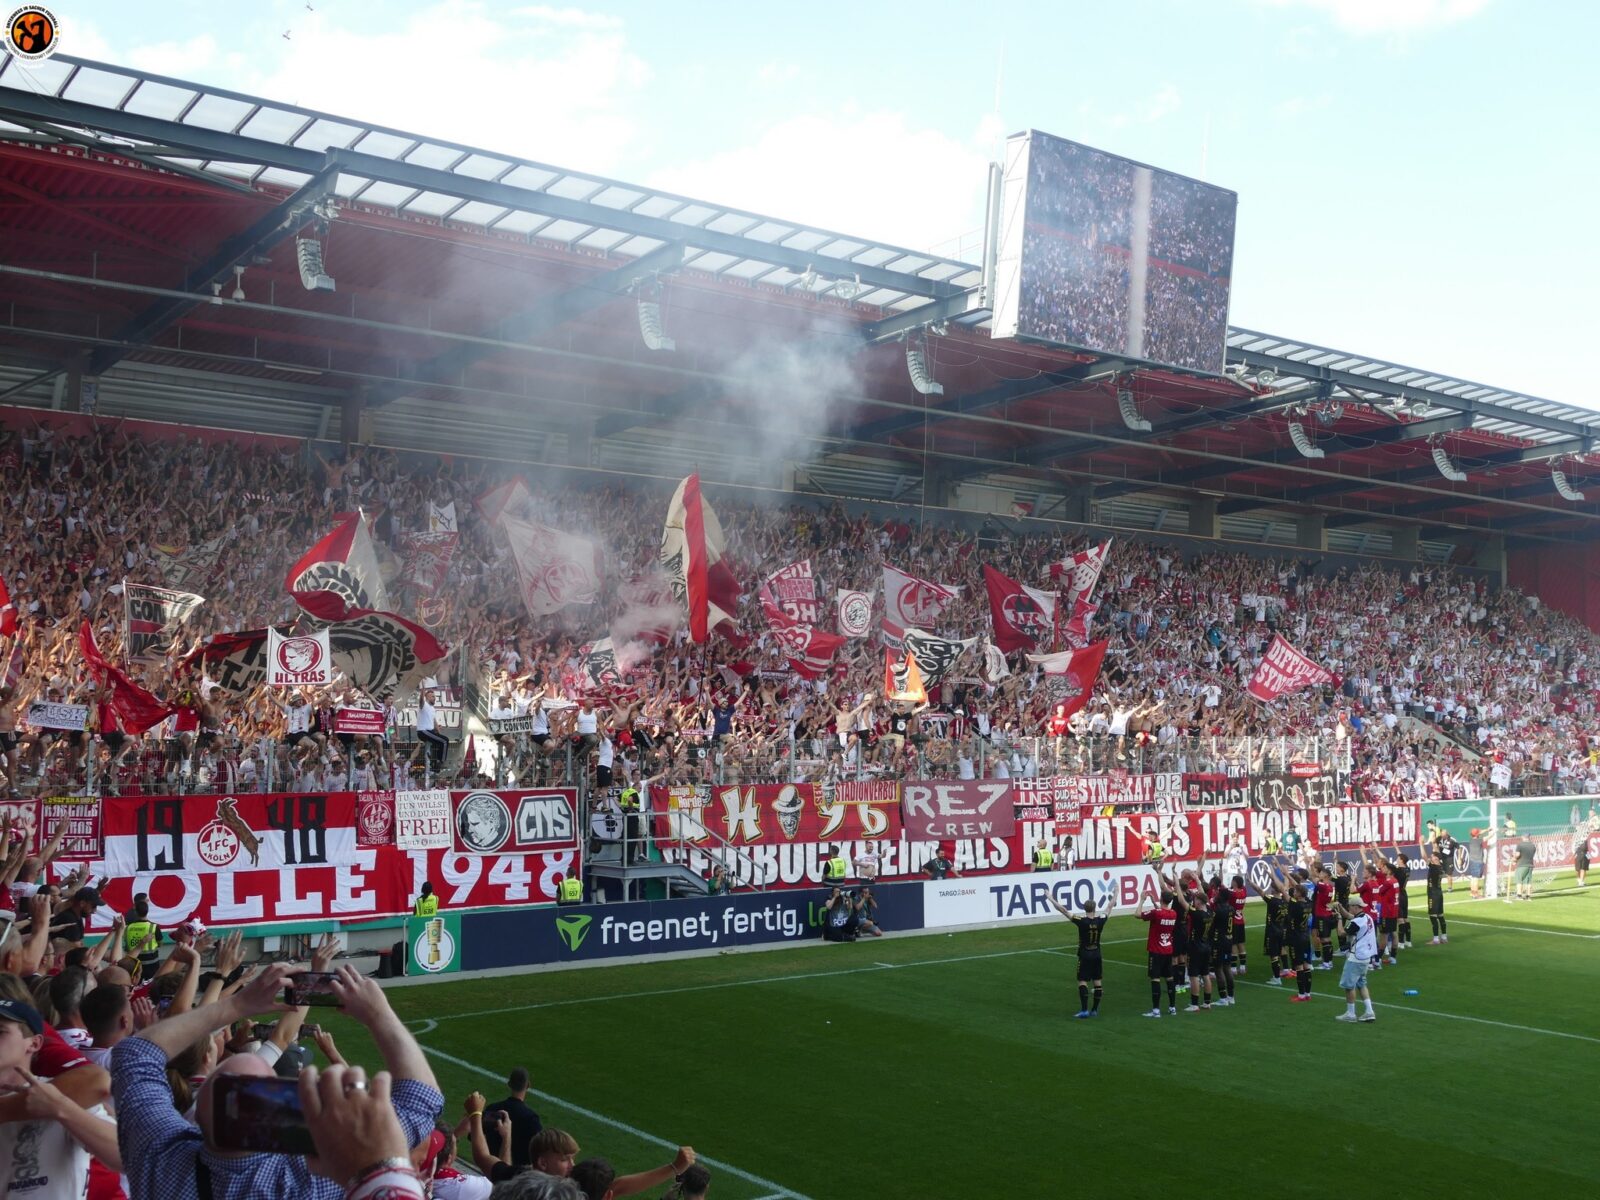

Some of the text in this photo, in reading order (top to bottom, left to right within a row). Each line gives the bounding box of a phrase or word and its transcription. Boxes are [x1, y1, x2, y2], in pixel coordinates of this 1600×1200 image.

[275, 670, 326, 683] ULTRAS
[836, 782, 897, 801] STADIONVERBOT
[1013, 791, 1053, 805] JUNGS
[398, 802, 415, 810] TUN
[400, 818, 448, 836] FREI
[519, 801, 569, 840] CNS
[926, 821, 993, 836] CREW
[135, 797, 326, 872] 19 48
[954, 837, 1009, 871] ALS
[1318, 806, 1415, 846] ERHALTEN
[207, 838, 229, 852] 1.FC
[407, 849, 574, 908] 1948
[601, 910, 718, 943] freenet,
[722, 903, 804, 936] fertig,
